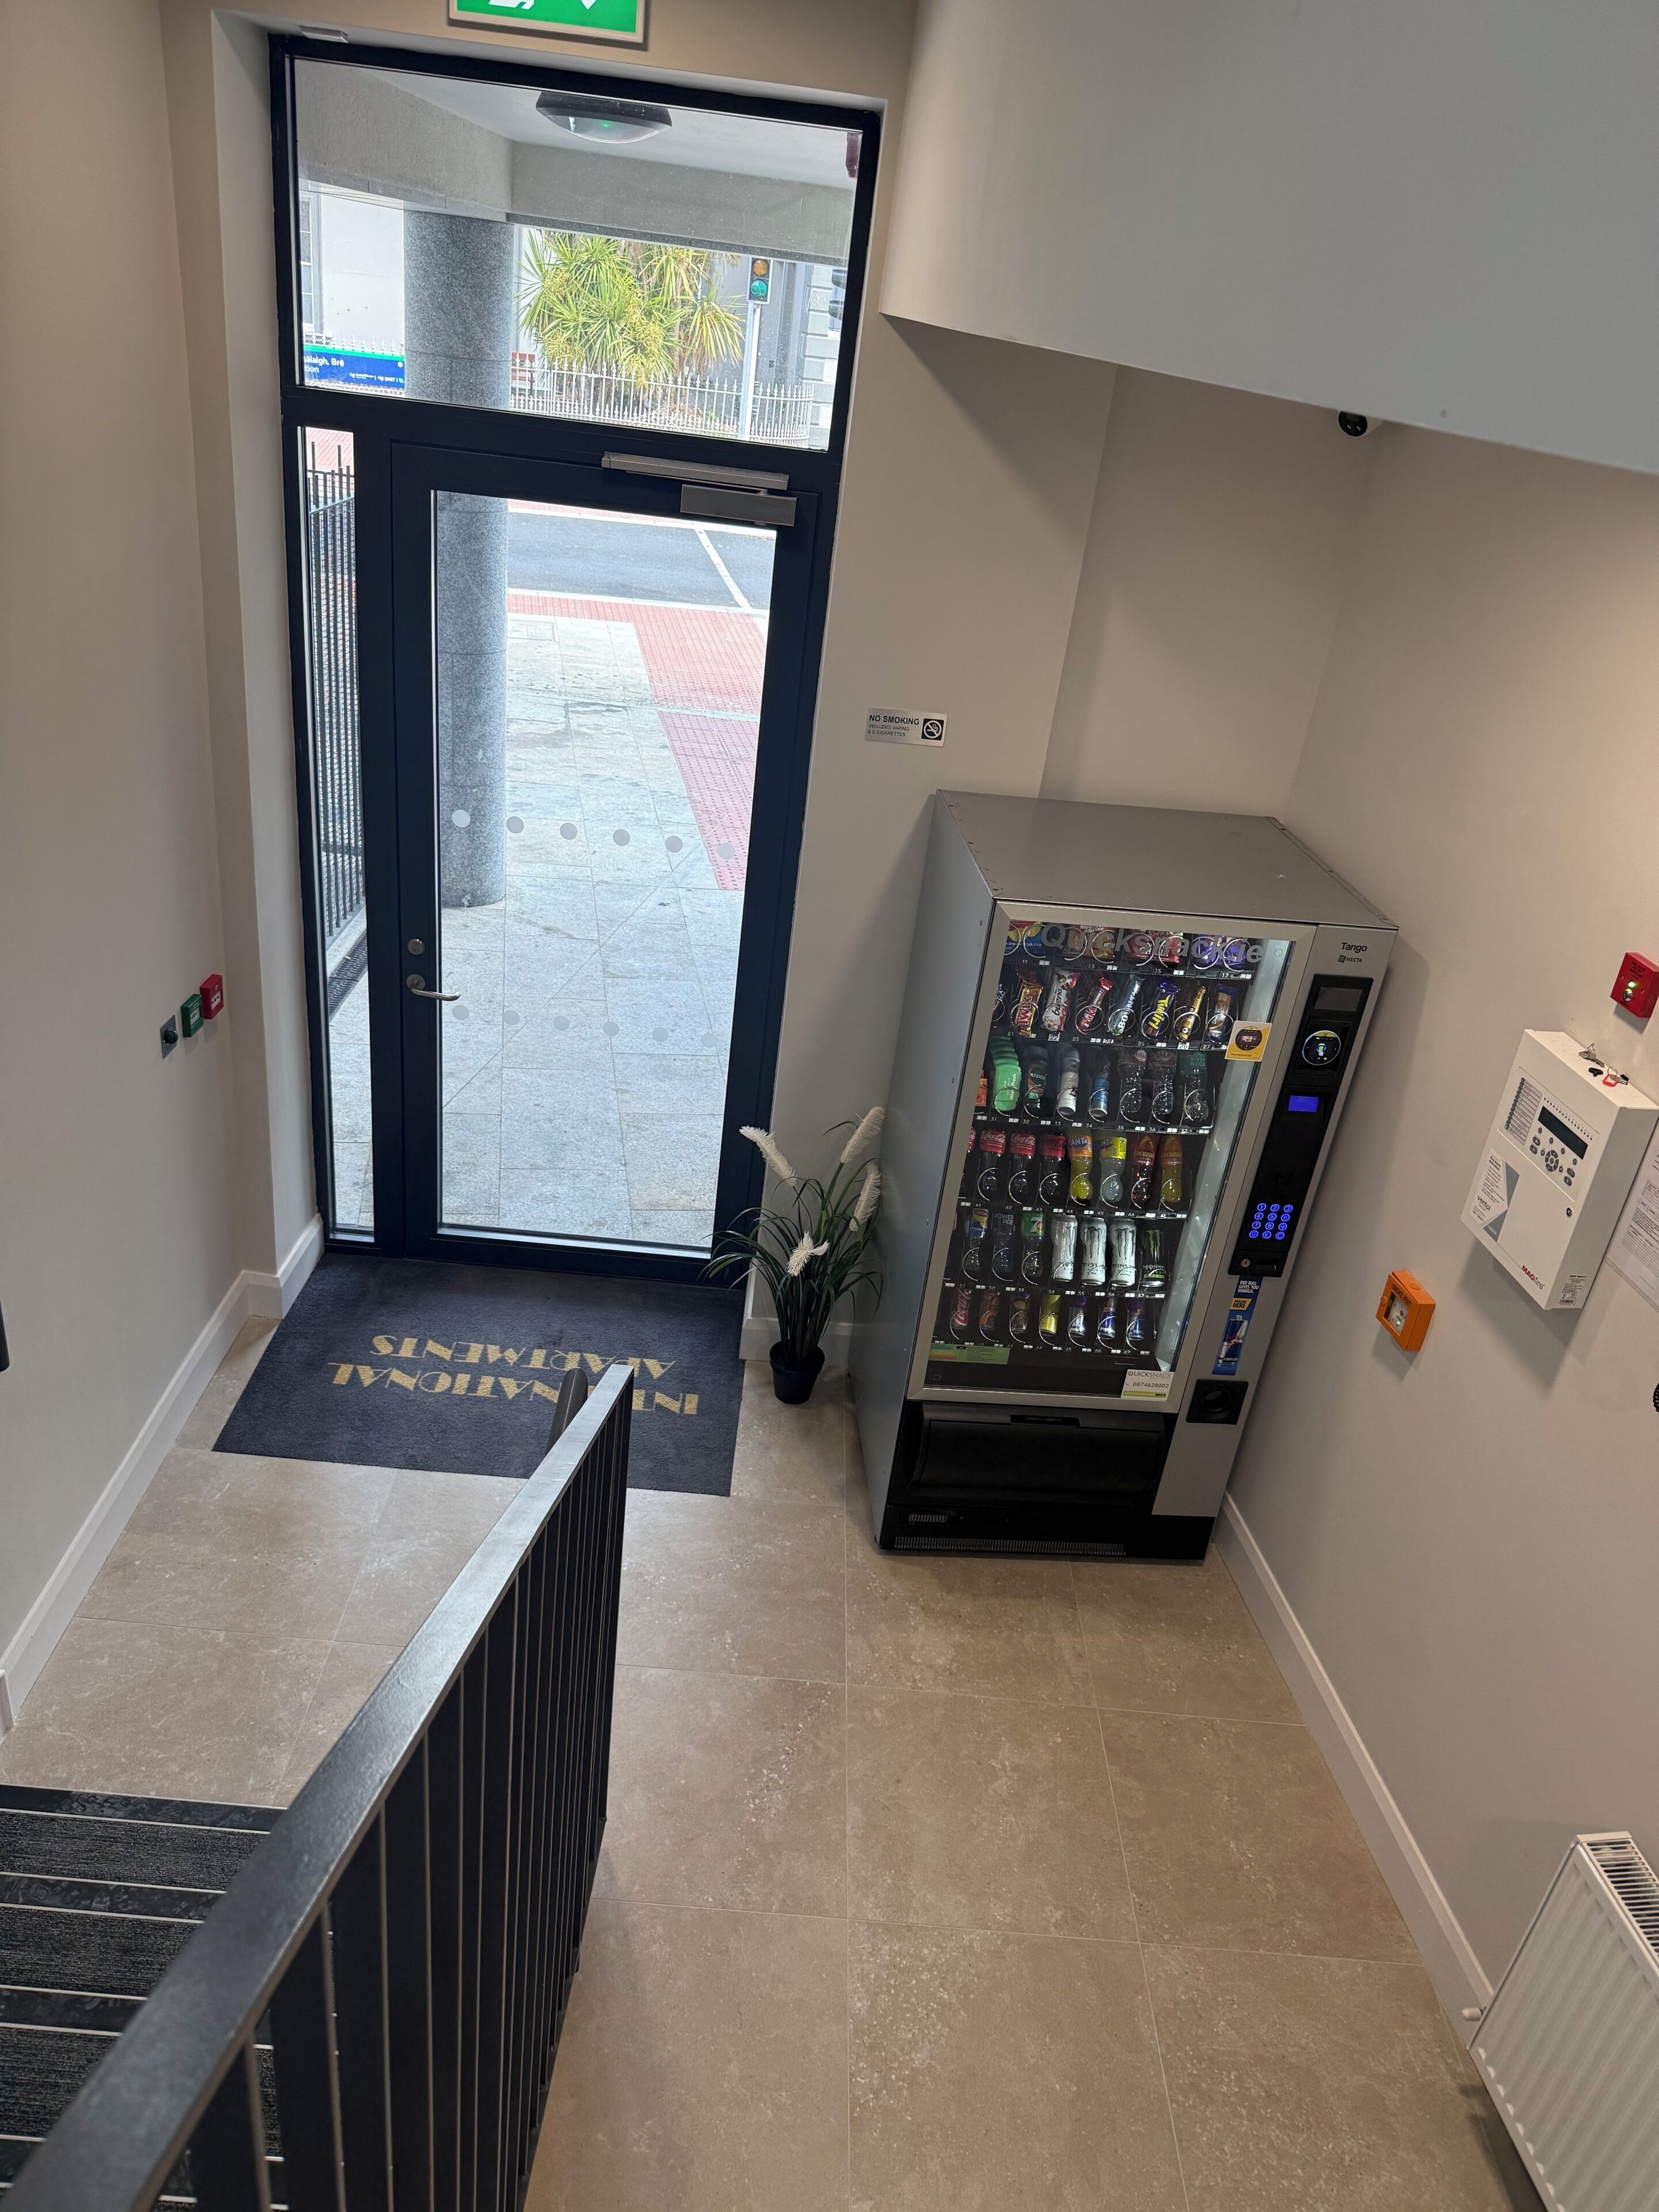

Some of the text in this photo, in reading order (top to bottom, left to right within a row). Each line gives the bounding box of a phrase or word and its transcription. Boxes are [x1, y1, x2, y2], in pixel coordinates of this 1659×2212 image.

[883, 715, 919, 725] SMOKING
[1041, 923, 1263, 963] Quicksnack.ie
[1341, 942, 1368, 953] Tango
[1052, 988, 1063, 1016] bueno
[1084, 1005, 1097, 1028] KitKa
[1147, 994, 1171, 1029] Twirl
[1030, 1073, 1046, 1081] RADOX
[1069, 1138, 1087, 1146] FANTA
